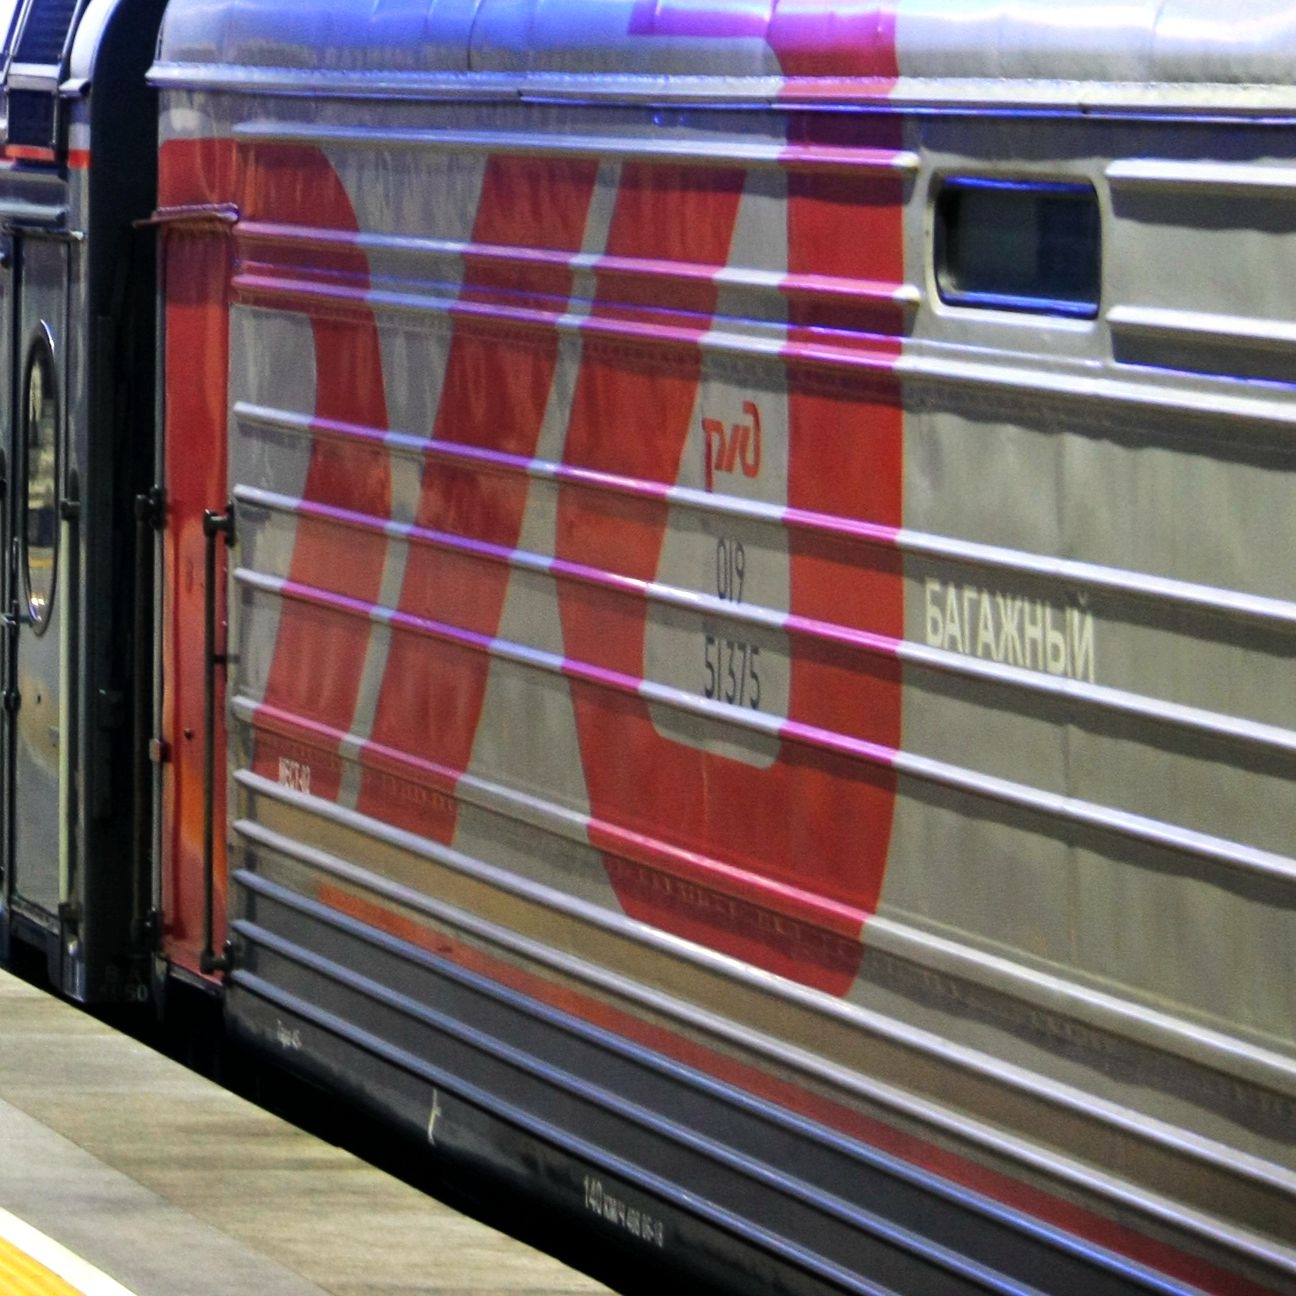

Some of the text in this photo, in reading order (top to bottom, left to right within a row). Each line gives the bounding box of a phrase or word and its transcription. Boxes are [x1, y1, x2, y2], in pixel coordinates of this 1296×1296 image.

[715, 538, 746, 604] 019
[923, 576, 1095, 683] БАГАЖНЫЙ
[703, 638, 760, 711] 51375
